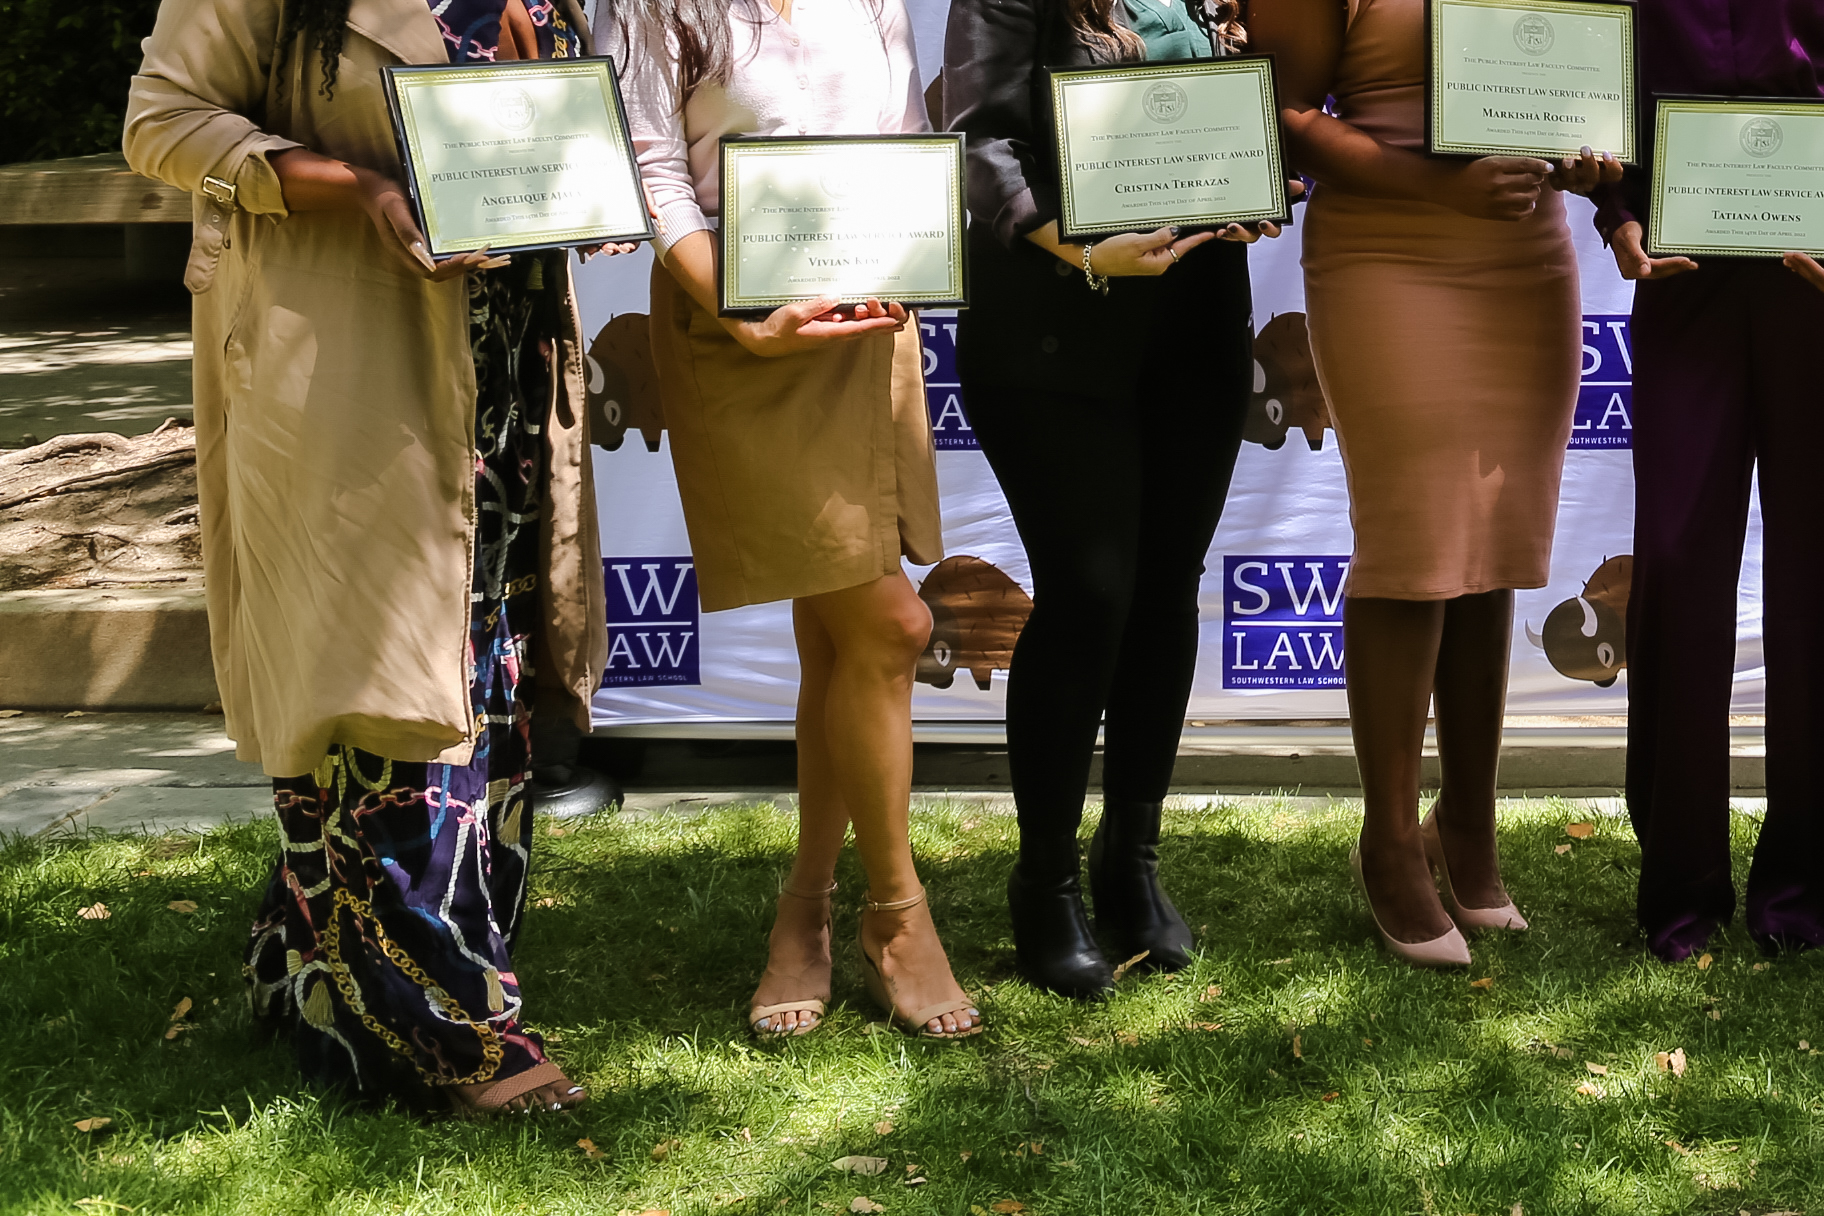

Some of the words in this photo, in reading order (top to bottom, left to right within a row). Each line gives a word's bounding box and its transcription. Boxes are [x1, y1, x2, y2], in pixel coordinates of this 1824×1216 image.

[1446, 82, 1480, 92] PUBLIC
[1482, 84, 1526, 95] INTEREST
[1527, 87, 1547, 96] LAW
[1549, 88, 1586, 99] SERVICE
[1587, 91, 1620, 101] AWARD
[1543, 111, 1585, 124] ROCHES
[1074, 160, 1111, 171] PUBLIC
[1114, 156, 1160, 168] INTEREST
[1163, 155, 1183, 165] LAW
[1186, 151, 1227, 163] SERVICE
[1229, 149, 1264, 160] AWARD
[431, 170, 469, 183] PUBLIC
[471, 166, 516, 179] INTEREST
[520, 164, 539, 174] LAW
[1114, 179, 1168, 194] CRISTINA
[1170, 174, 1230, 189] TERRAZAS
[1667, 186, 1701, 195] PUBLIC
[1704, 187, 1749, 196] INTEREST
[1751, 188, 1771, 197] LAW
[1773, 189, 1811, 198] SERVICE
[1711, 210, 1757, 221] TATIANA
[1761, 211, 1801, 222] OWENS
[742, 234, 781, 243] PUBLIC
[784, 233, 833, 242] INTEREST
[907, 230, 944, 239] AWARD
[612, 564, 693, 615] W
[1233, 562, 1350, 615] SW
[605, 632, 693, 669] AW
[1232, 632, 1345, 670] LAW
